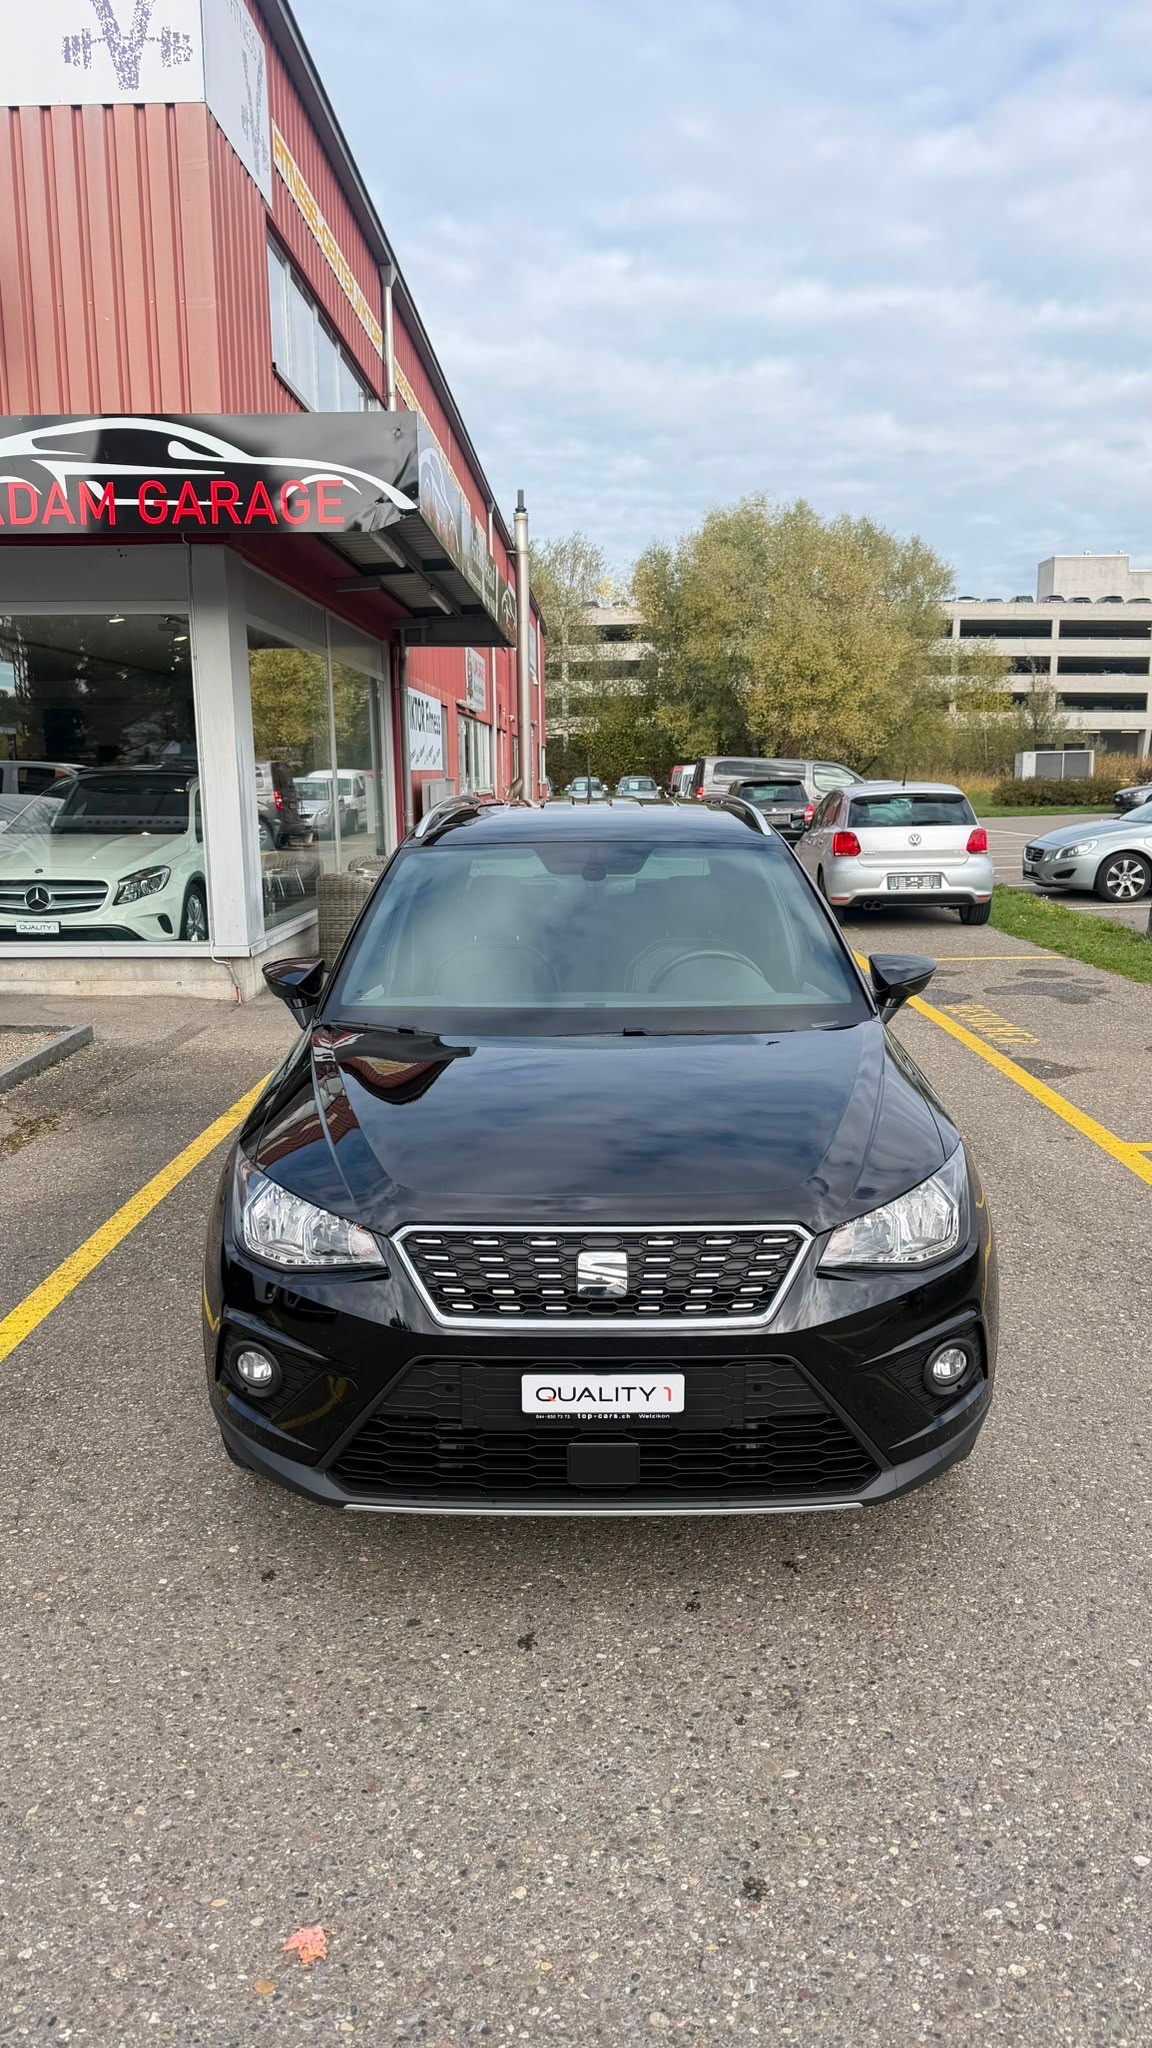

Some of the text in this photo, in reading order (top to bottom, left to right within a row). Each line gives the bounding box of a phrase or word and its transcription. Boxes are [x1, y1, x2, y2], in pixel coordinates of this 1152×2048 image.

[0, 479, 346, 526] DAM GARAGE
[535, 1386, 672, 1402] QUALITY 1
[577, 1412, 631, 1420] top-cars.ch
